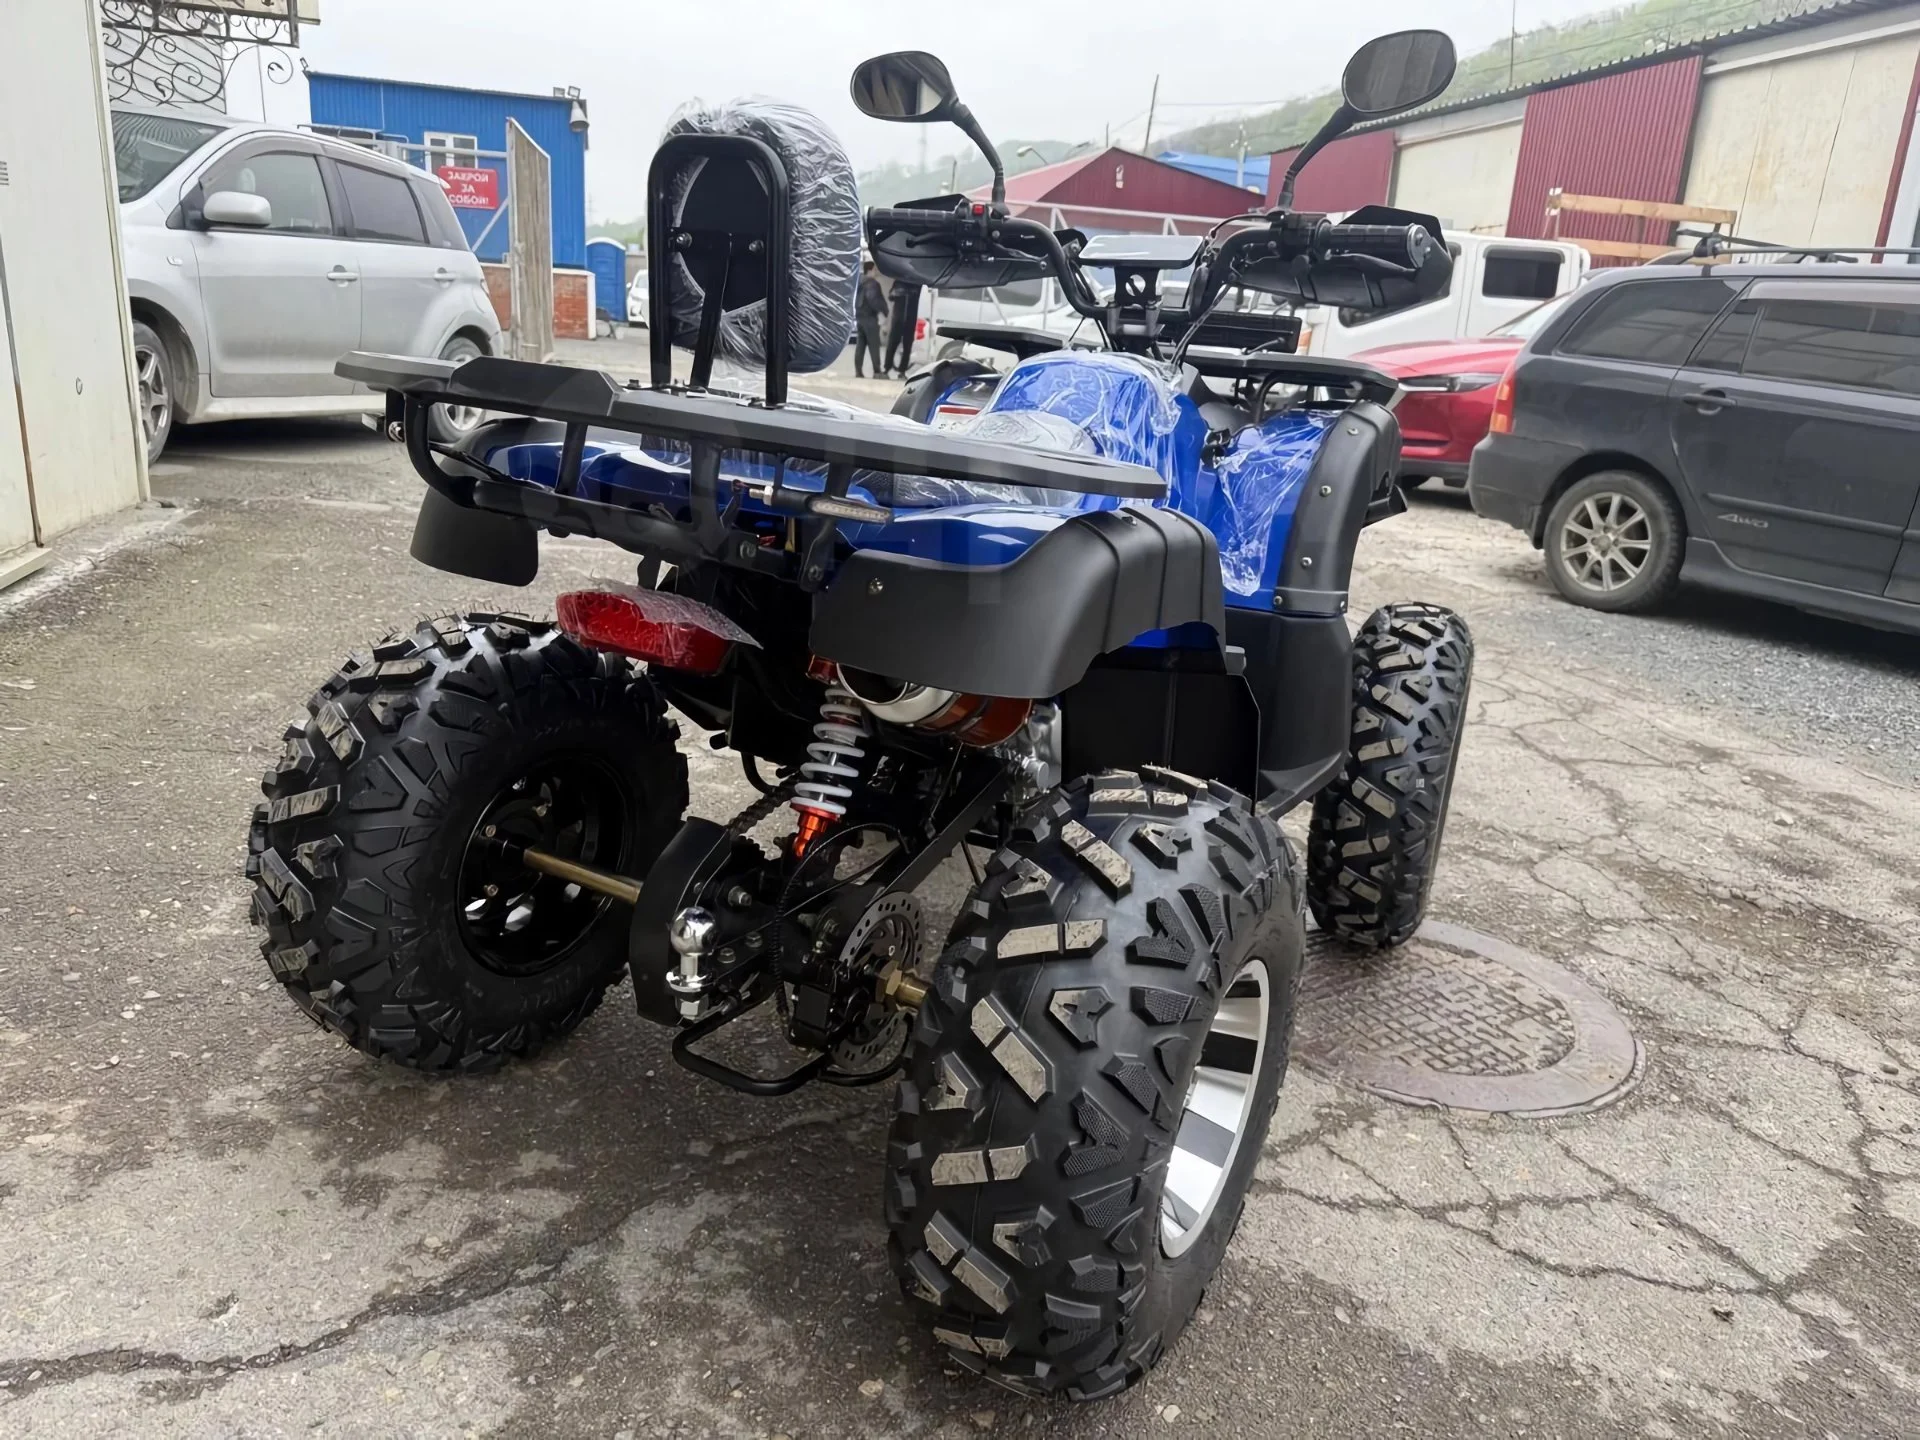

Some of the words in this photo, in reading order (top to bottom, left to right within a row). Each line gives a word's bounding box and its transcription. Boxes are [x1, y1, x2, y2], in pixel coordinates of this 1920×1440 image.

[447, 171, 489, 183] ЗАКРОЙ
[461, 183, 476, 193] ЗА
[448, 194, 489, 205] СОБОЙ!
